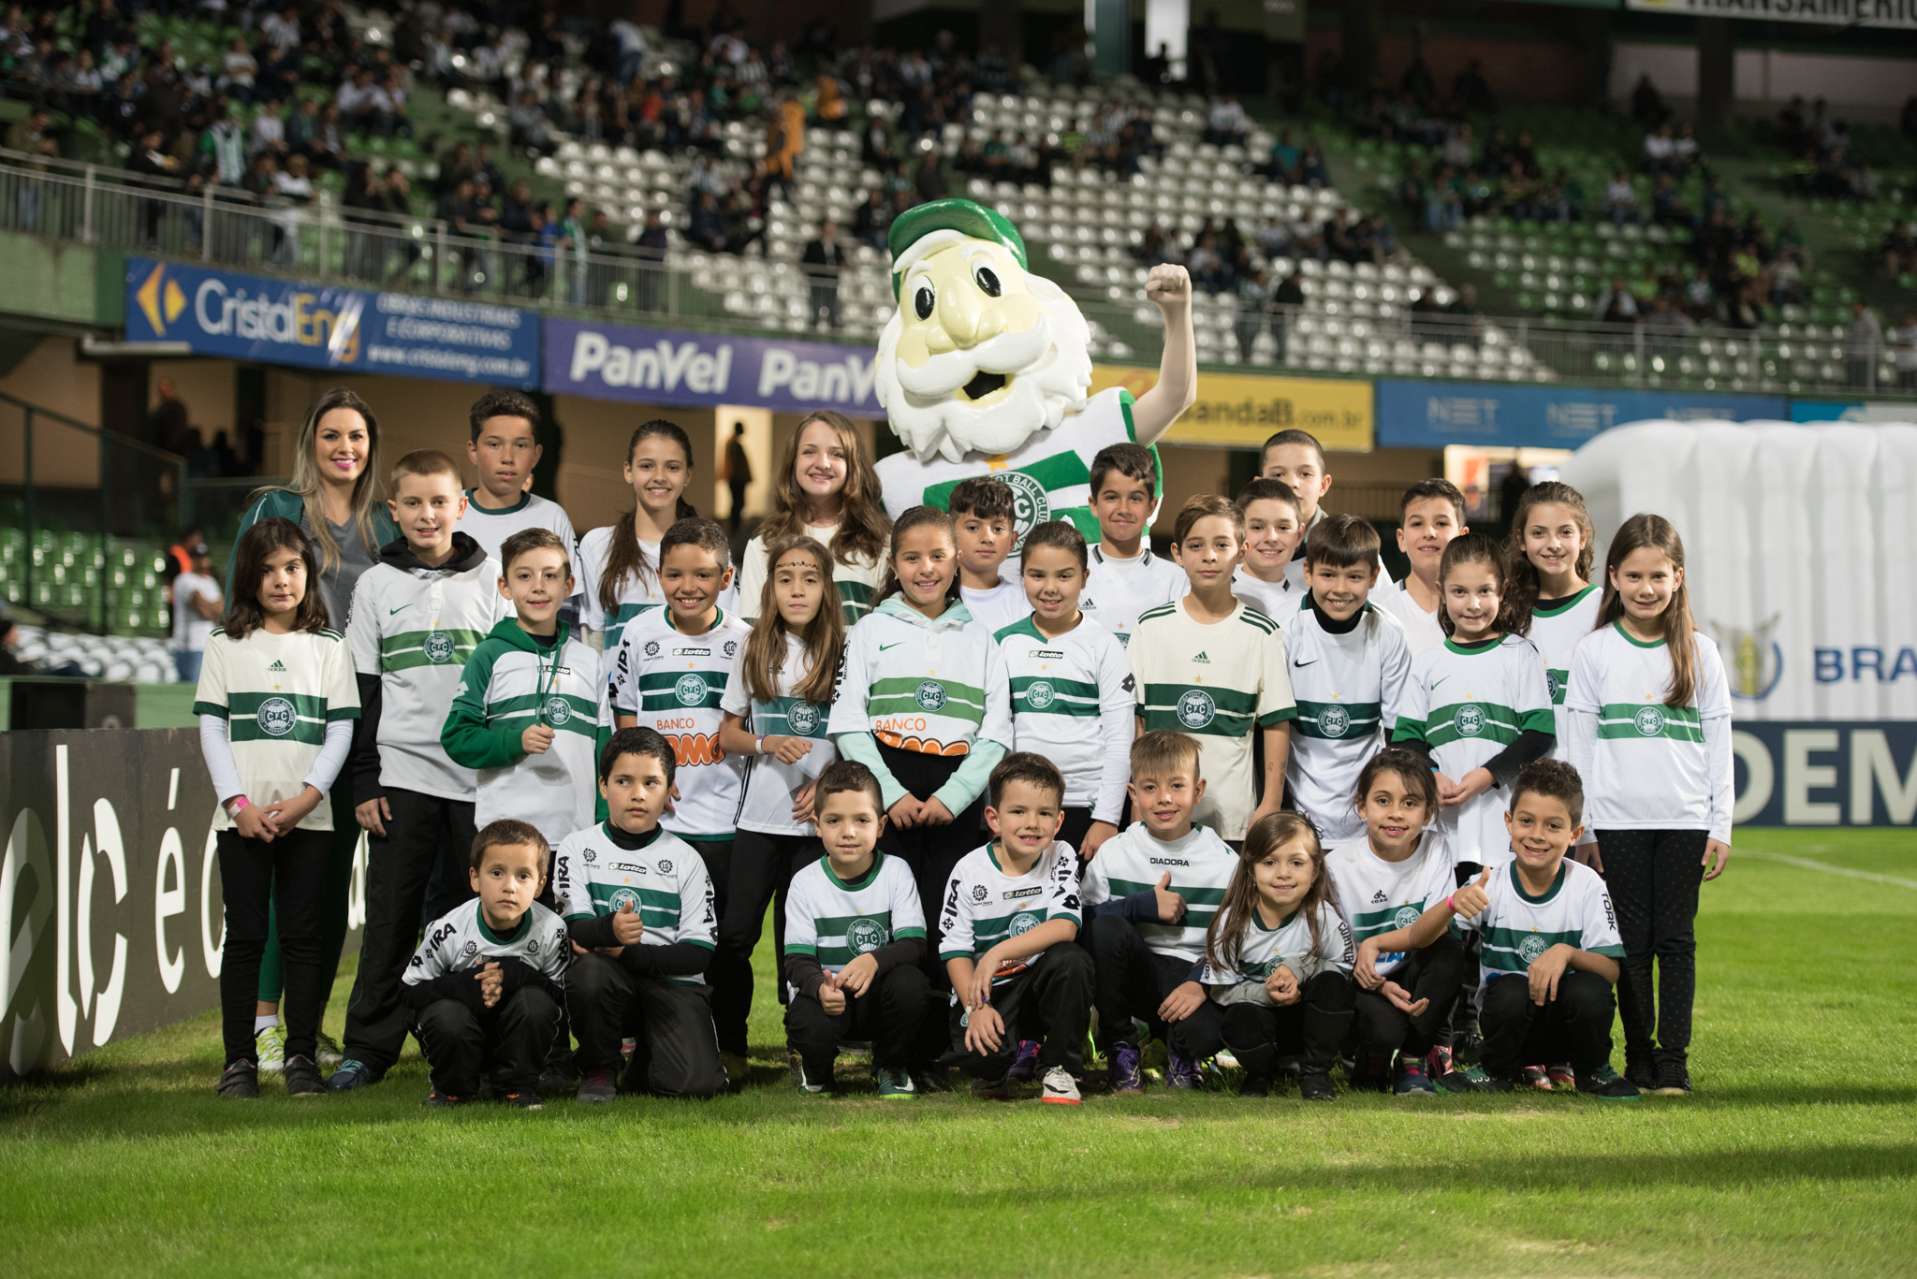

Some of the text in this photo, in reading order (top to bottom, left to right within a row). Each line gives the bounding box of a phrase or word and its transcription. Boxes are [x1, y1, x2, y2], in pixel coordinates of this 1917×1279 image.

[570, 330, 733, 395] PanVel
[758, 349, 876, 405] PanV
[1813, 644, 1917, 684] BRA
[656, 718, 695, 730] BANCO
[875, 717, 927, 731] BANCO
[557, 855, 570, 889] IRA
[1150, 857, 1190, 867] DIADORA
[429, 922, 457, 951] IRA
